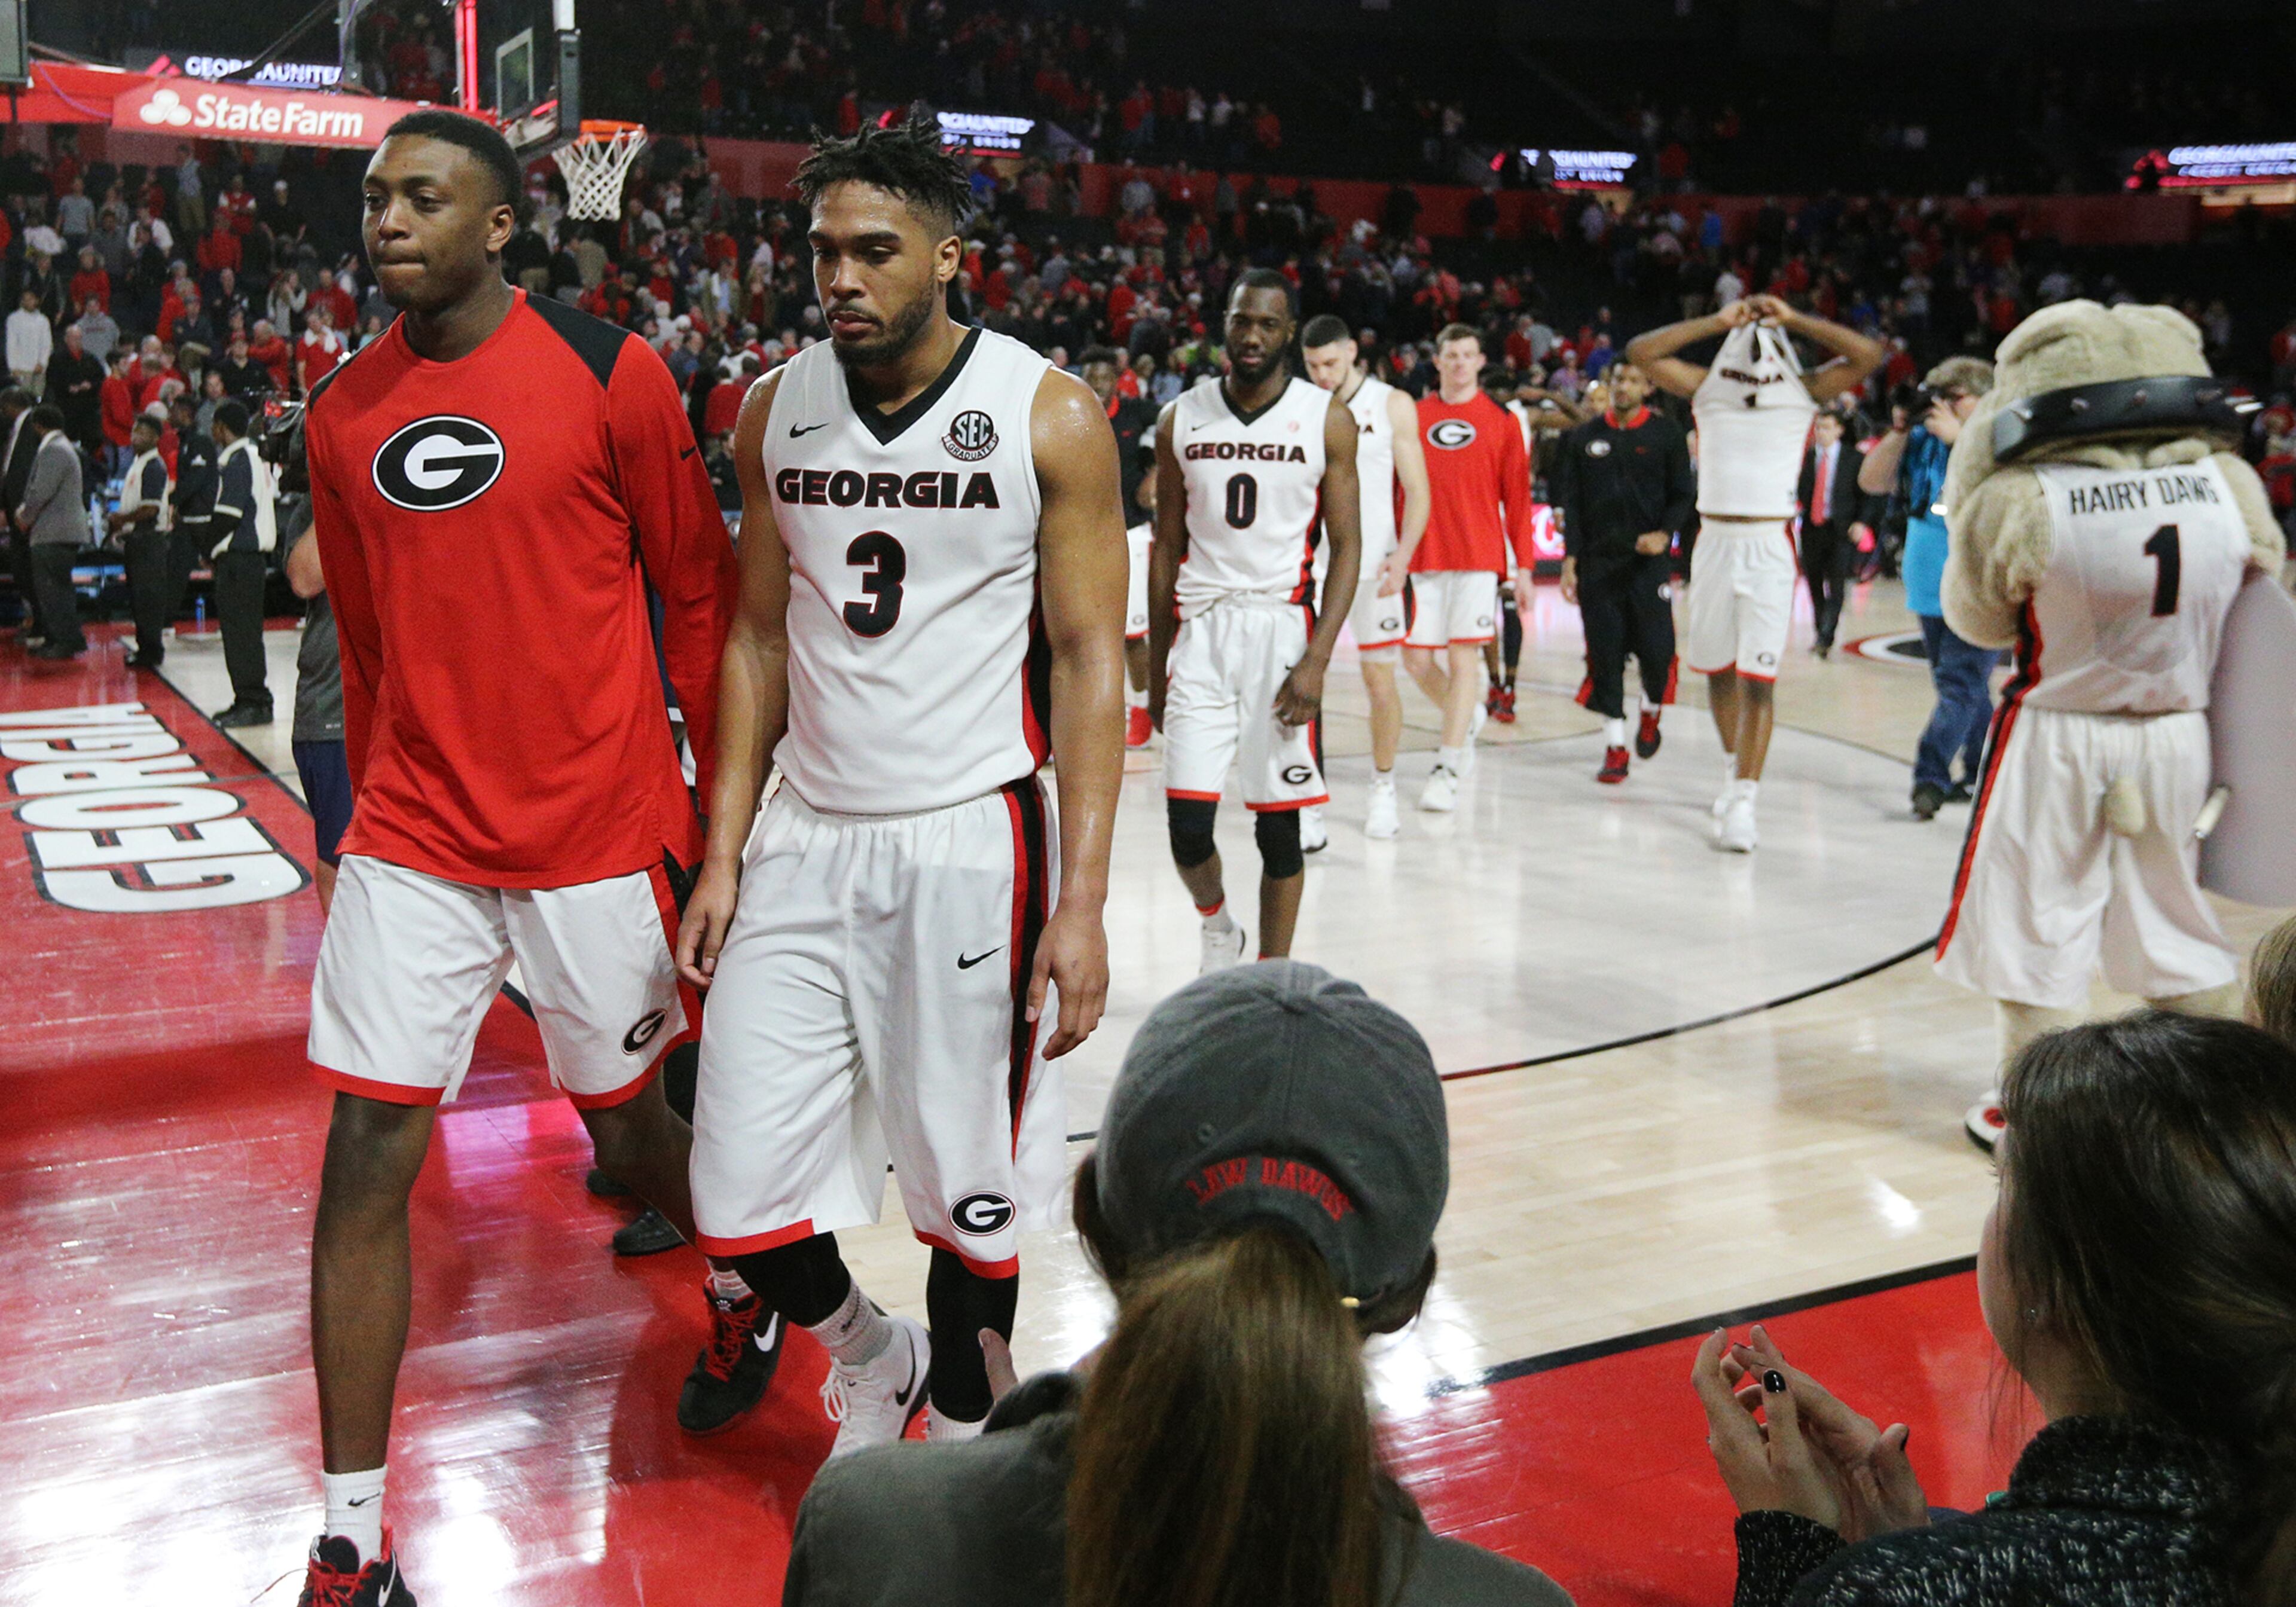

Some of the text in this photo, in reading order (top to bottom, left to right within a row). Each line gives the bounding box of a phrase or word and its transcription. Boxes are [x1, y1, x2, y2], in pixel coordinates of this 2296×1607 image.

[955, 413, 991, 448] SEC
[1185, 442, 1306, 464] GEORGIA
[1427, 418, 1477, 450] G
[371, 414, 505, 511] G
[777, 468, 1000, 509] GEORGIA
[1225, 472, 1257, 530] 0
[2069, 481, 2148, 515] HAIRY
[843, 530, 906, 638] 3
[2143, 524, 2181, 618] 1
[1281, 765, 1312, 785] G
[0, 702, 311, 913] GEORGIA
[621, 1008, 668, 1055] G
[948, 1191, 1015, 1236] G
